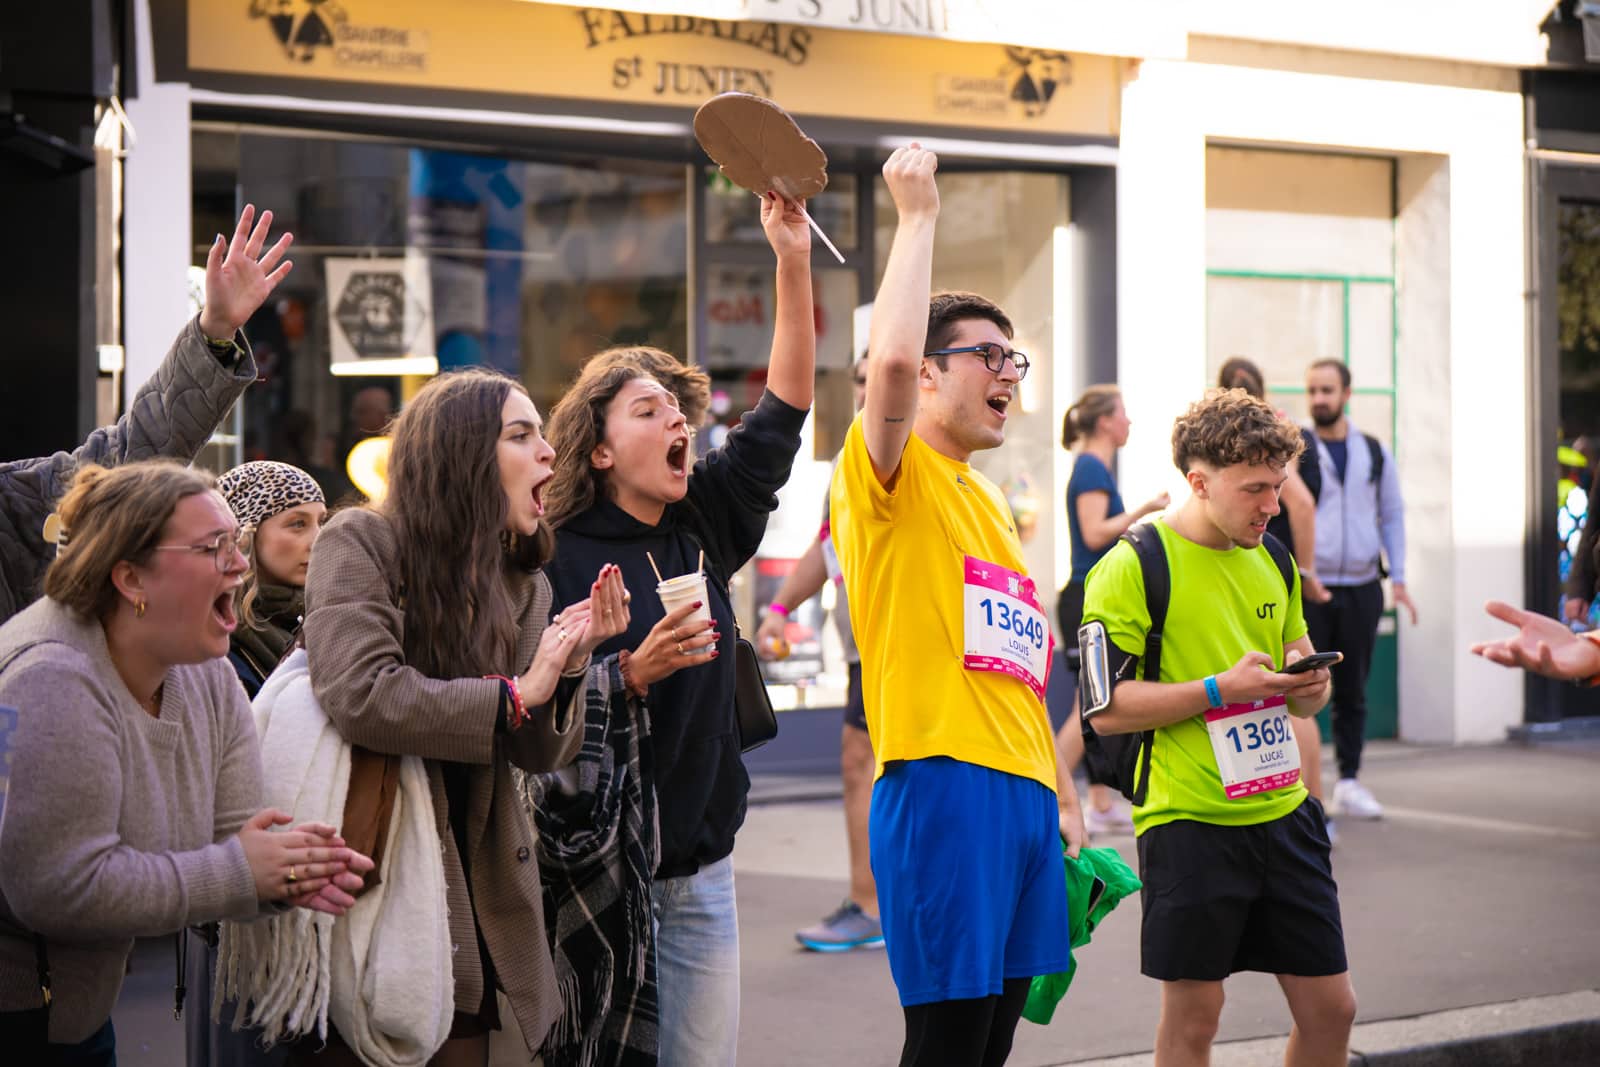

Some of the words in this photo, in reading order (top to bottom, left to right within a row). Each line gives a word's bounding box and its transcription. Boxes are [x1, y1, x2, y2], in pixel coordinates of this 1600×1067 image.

[612, 55, 643, 89] St
[653, 61, 774, 98] JUNIEN
[980, 598, 1044, 649] 13649
[1009, 638, 1029, 656] LOUIS
[1226, 715, 1292, 753] 13692
[1260, 750, 1284, 763] LUCAS
